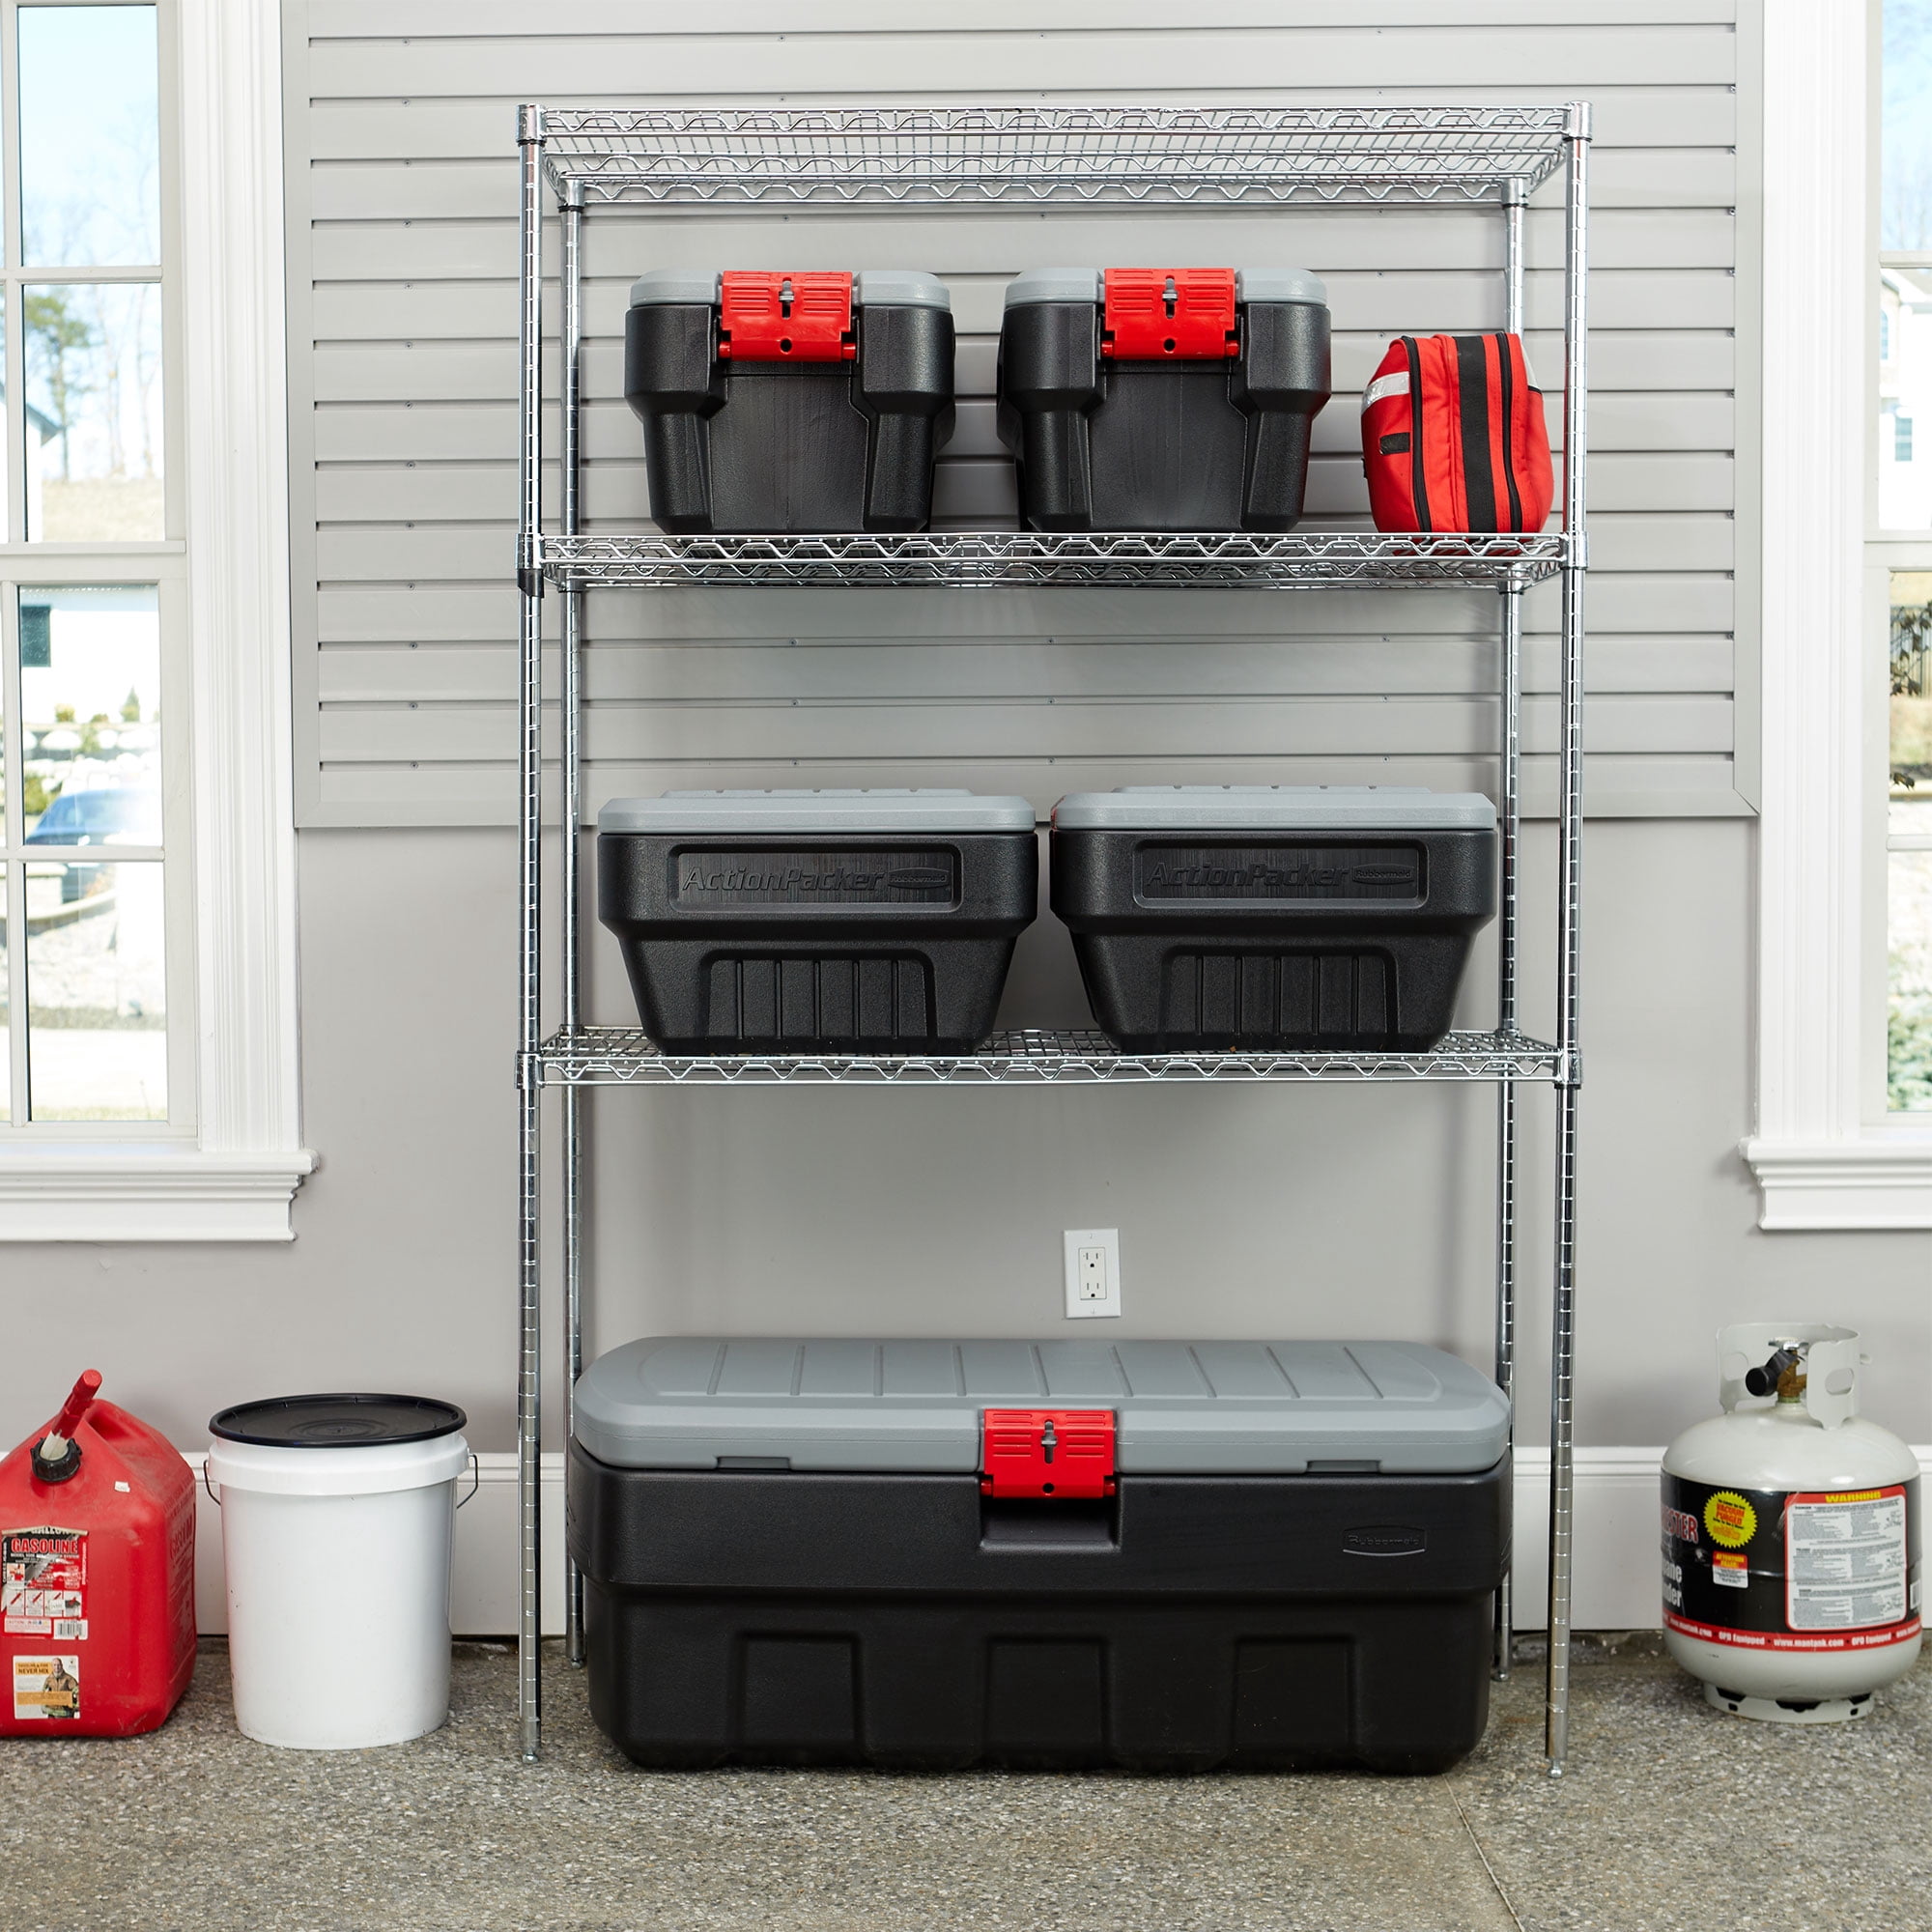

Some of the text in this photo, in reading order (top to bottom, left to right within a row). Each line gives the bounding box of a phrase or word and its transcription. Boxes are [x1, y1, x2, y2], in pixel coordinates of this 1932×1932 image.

[682, 866, 948, 891] ActionPacker Rubbermaid
[1147, 862, 1411, 887] ActionPacker Rubbermaid
[1825, 1491, 1881, 1503] WARNING
[11, 1538, 78, 1554] GASOLINE
[1662, 1558, 1682, 1583] ane
